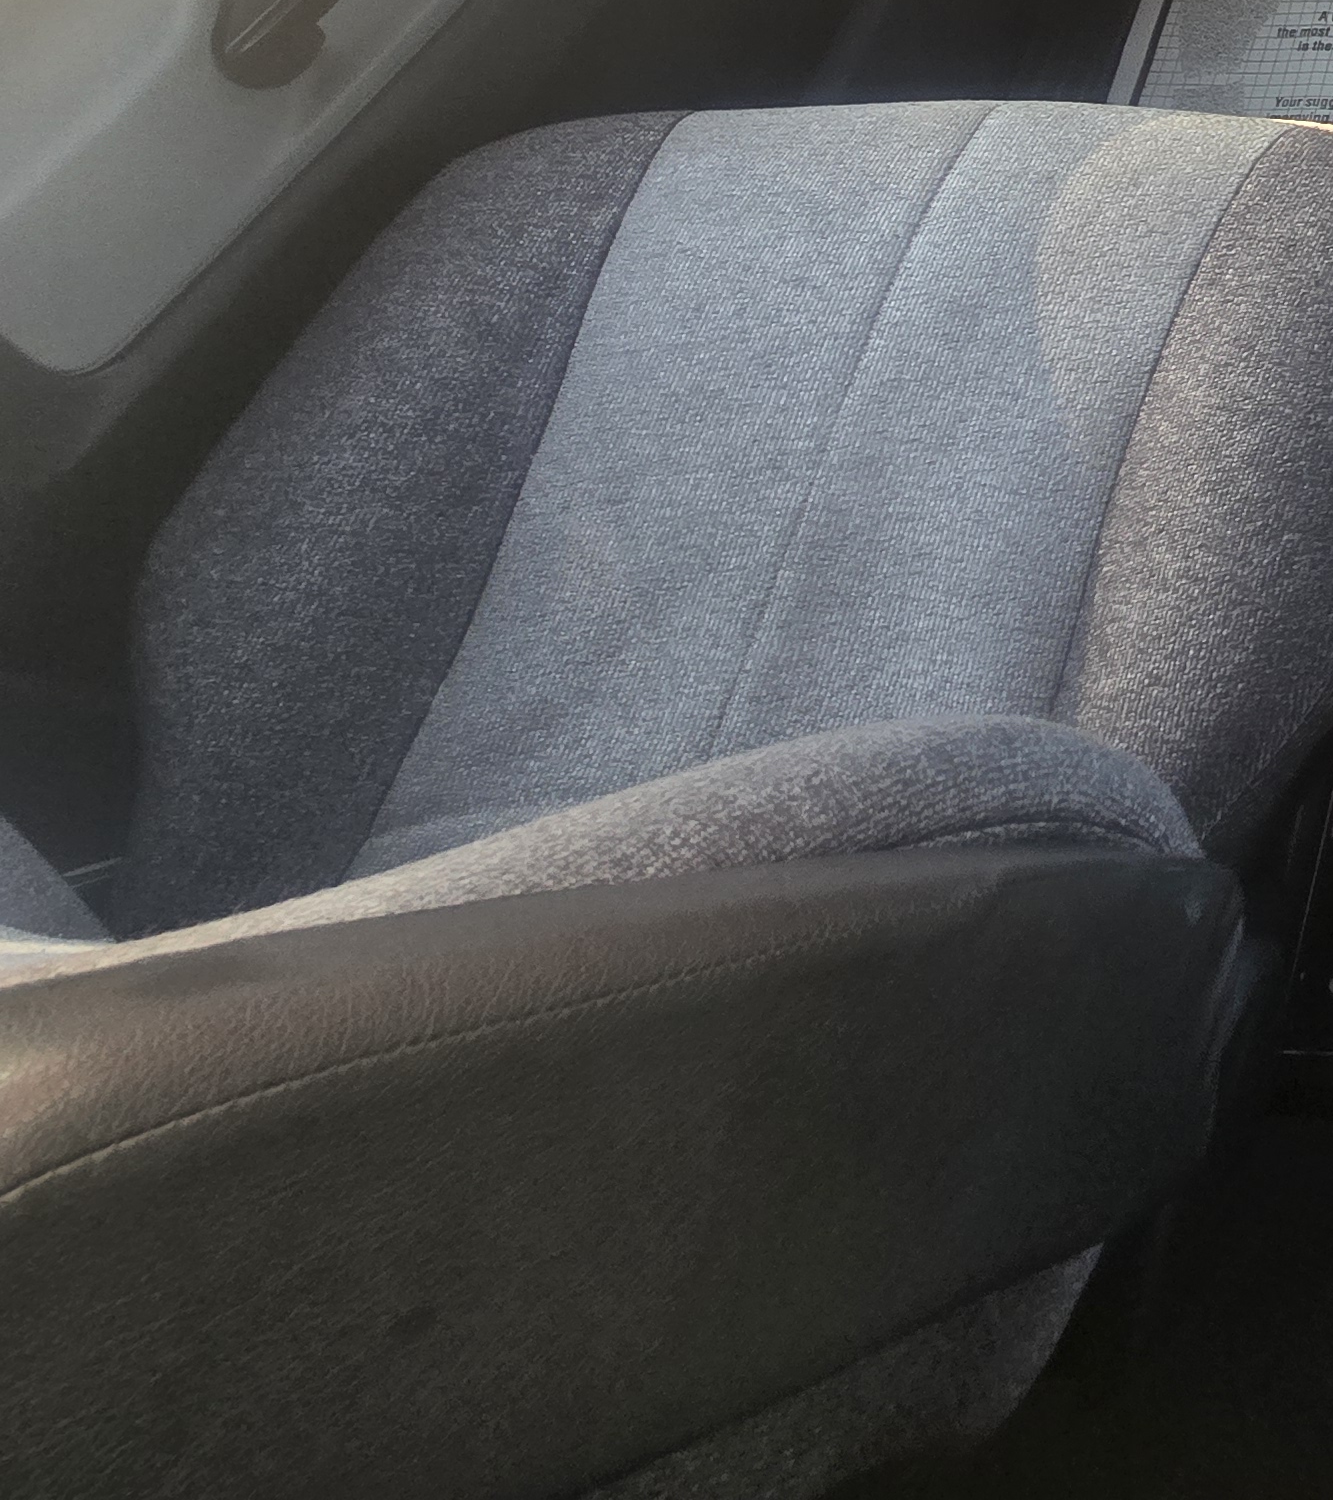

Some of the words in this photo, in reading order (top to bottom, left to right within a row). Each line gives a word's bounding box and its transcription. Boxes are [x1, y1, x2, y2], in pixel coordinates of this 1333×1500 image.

[1318, 11, 1328, 23] A
[1277, 27, 1297, 38] the
[1300, 27, 1330, 38] most
[1311, 40, 1332, 51] the
[1275, 97, 1303, 108] Your
